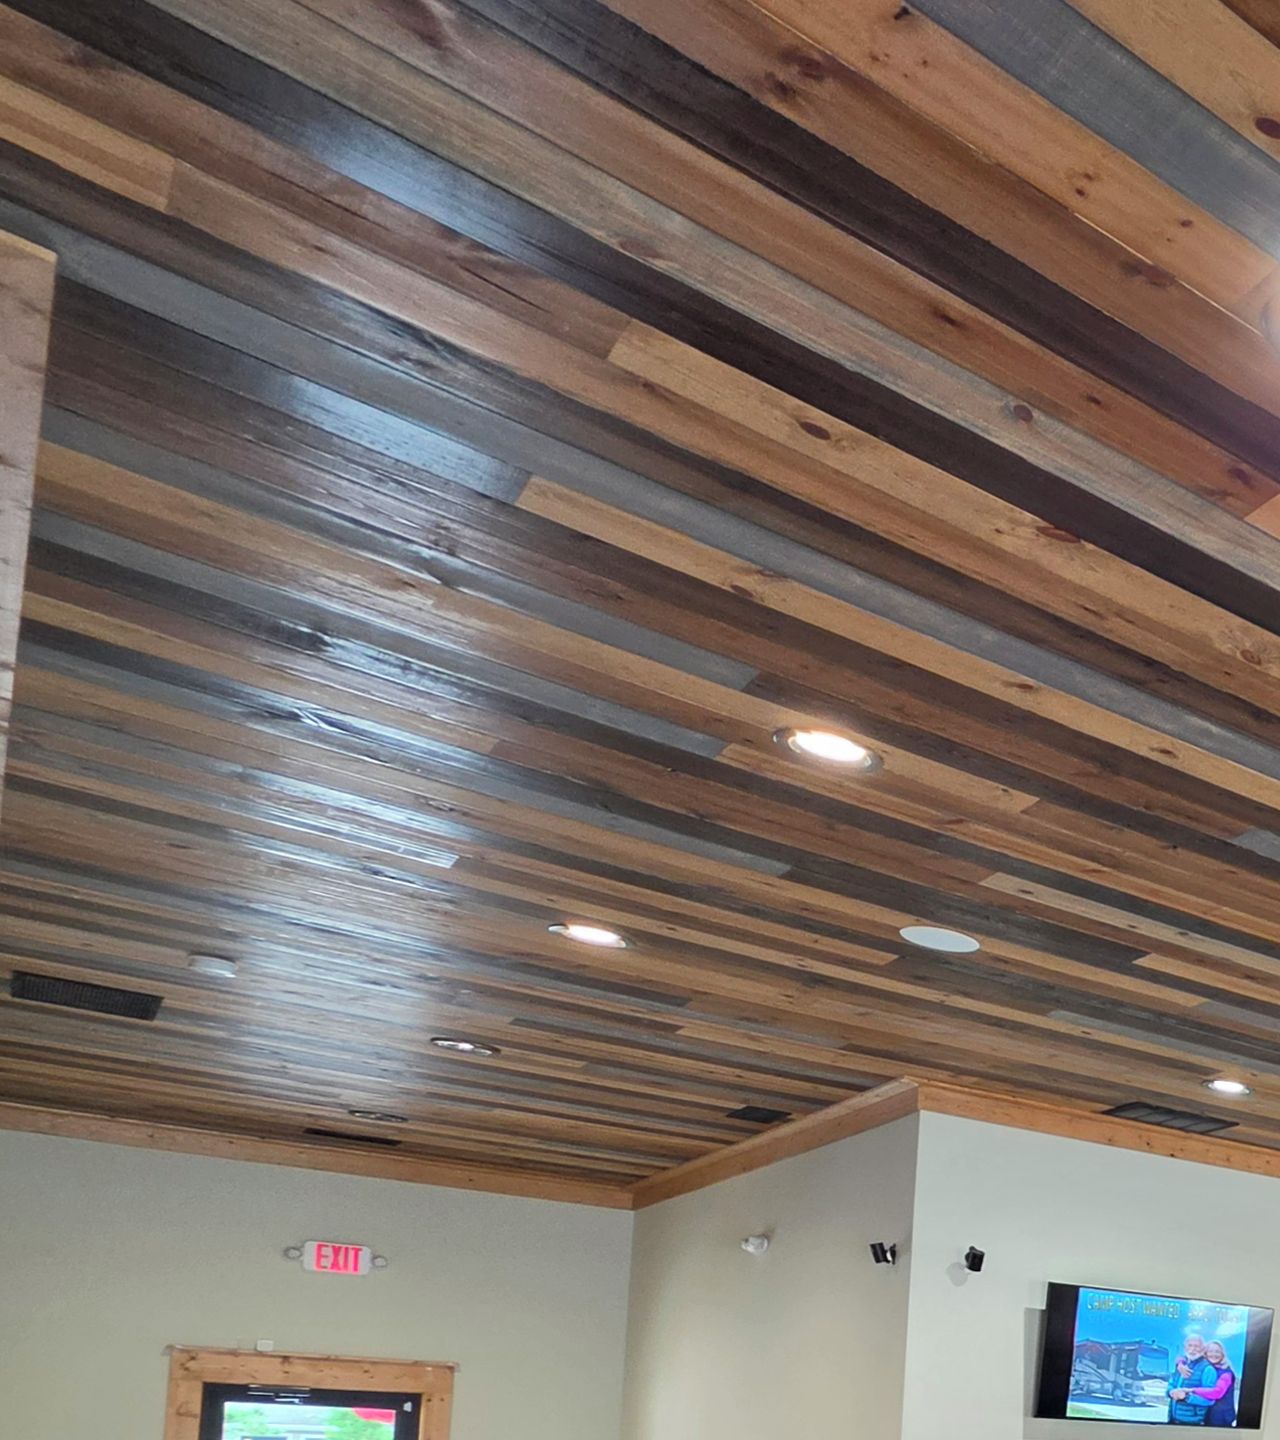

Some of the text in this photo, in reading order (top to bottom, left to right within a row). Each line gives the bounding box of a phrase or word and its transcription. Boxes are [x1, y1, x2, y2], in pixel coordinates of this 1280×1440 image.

[316, 1243, 363, 1273] EXIT
[1087, 1292, 1114, 1312] CAMP
[1143, 1299, 1181, 1319] WANTED
